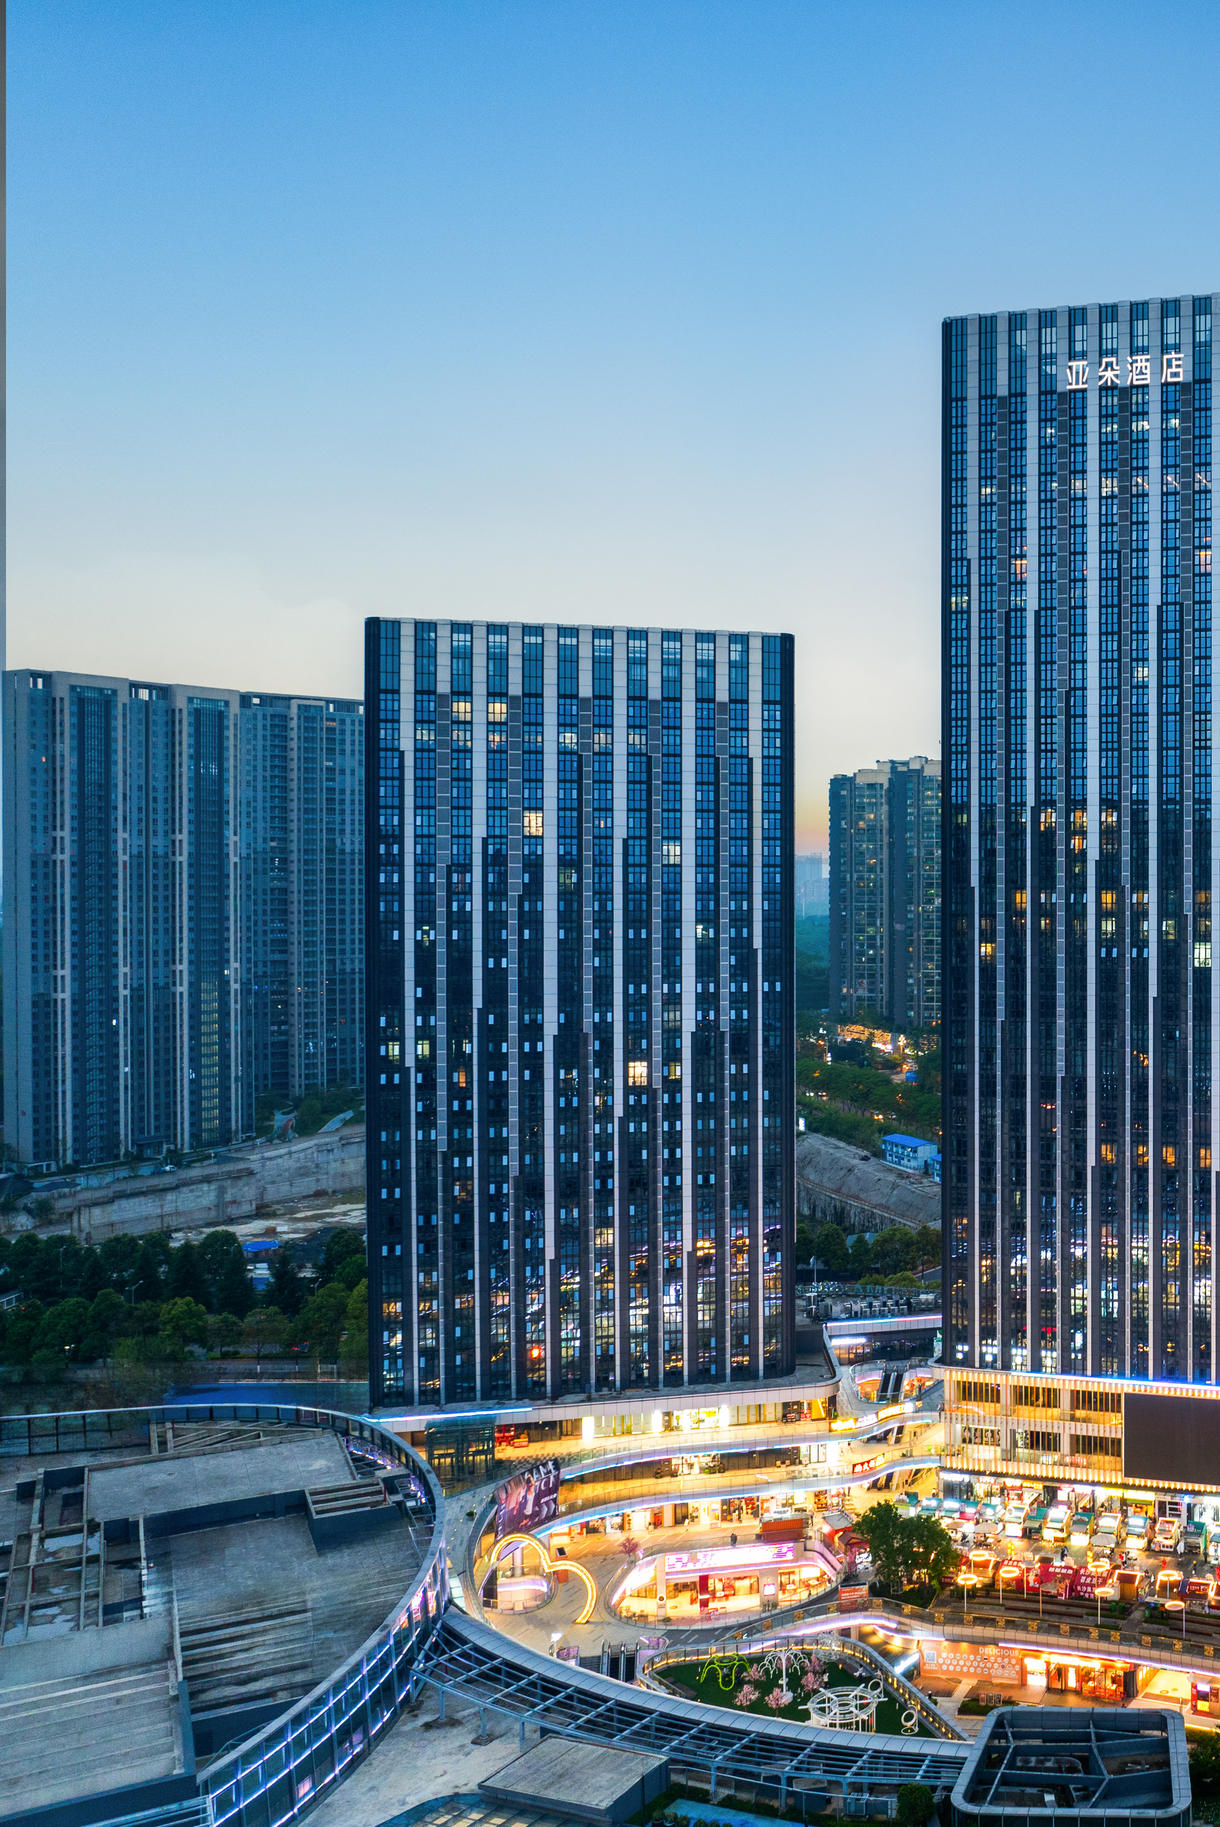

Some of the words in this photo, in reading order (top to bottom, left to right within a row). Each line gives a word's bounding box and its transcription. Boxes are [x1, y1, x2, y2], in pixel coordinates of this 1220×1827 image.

[1066, 351, 1184, 389] 亚朵酒店
[979, 1647, 1019, 1657] DELICIOUS
